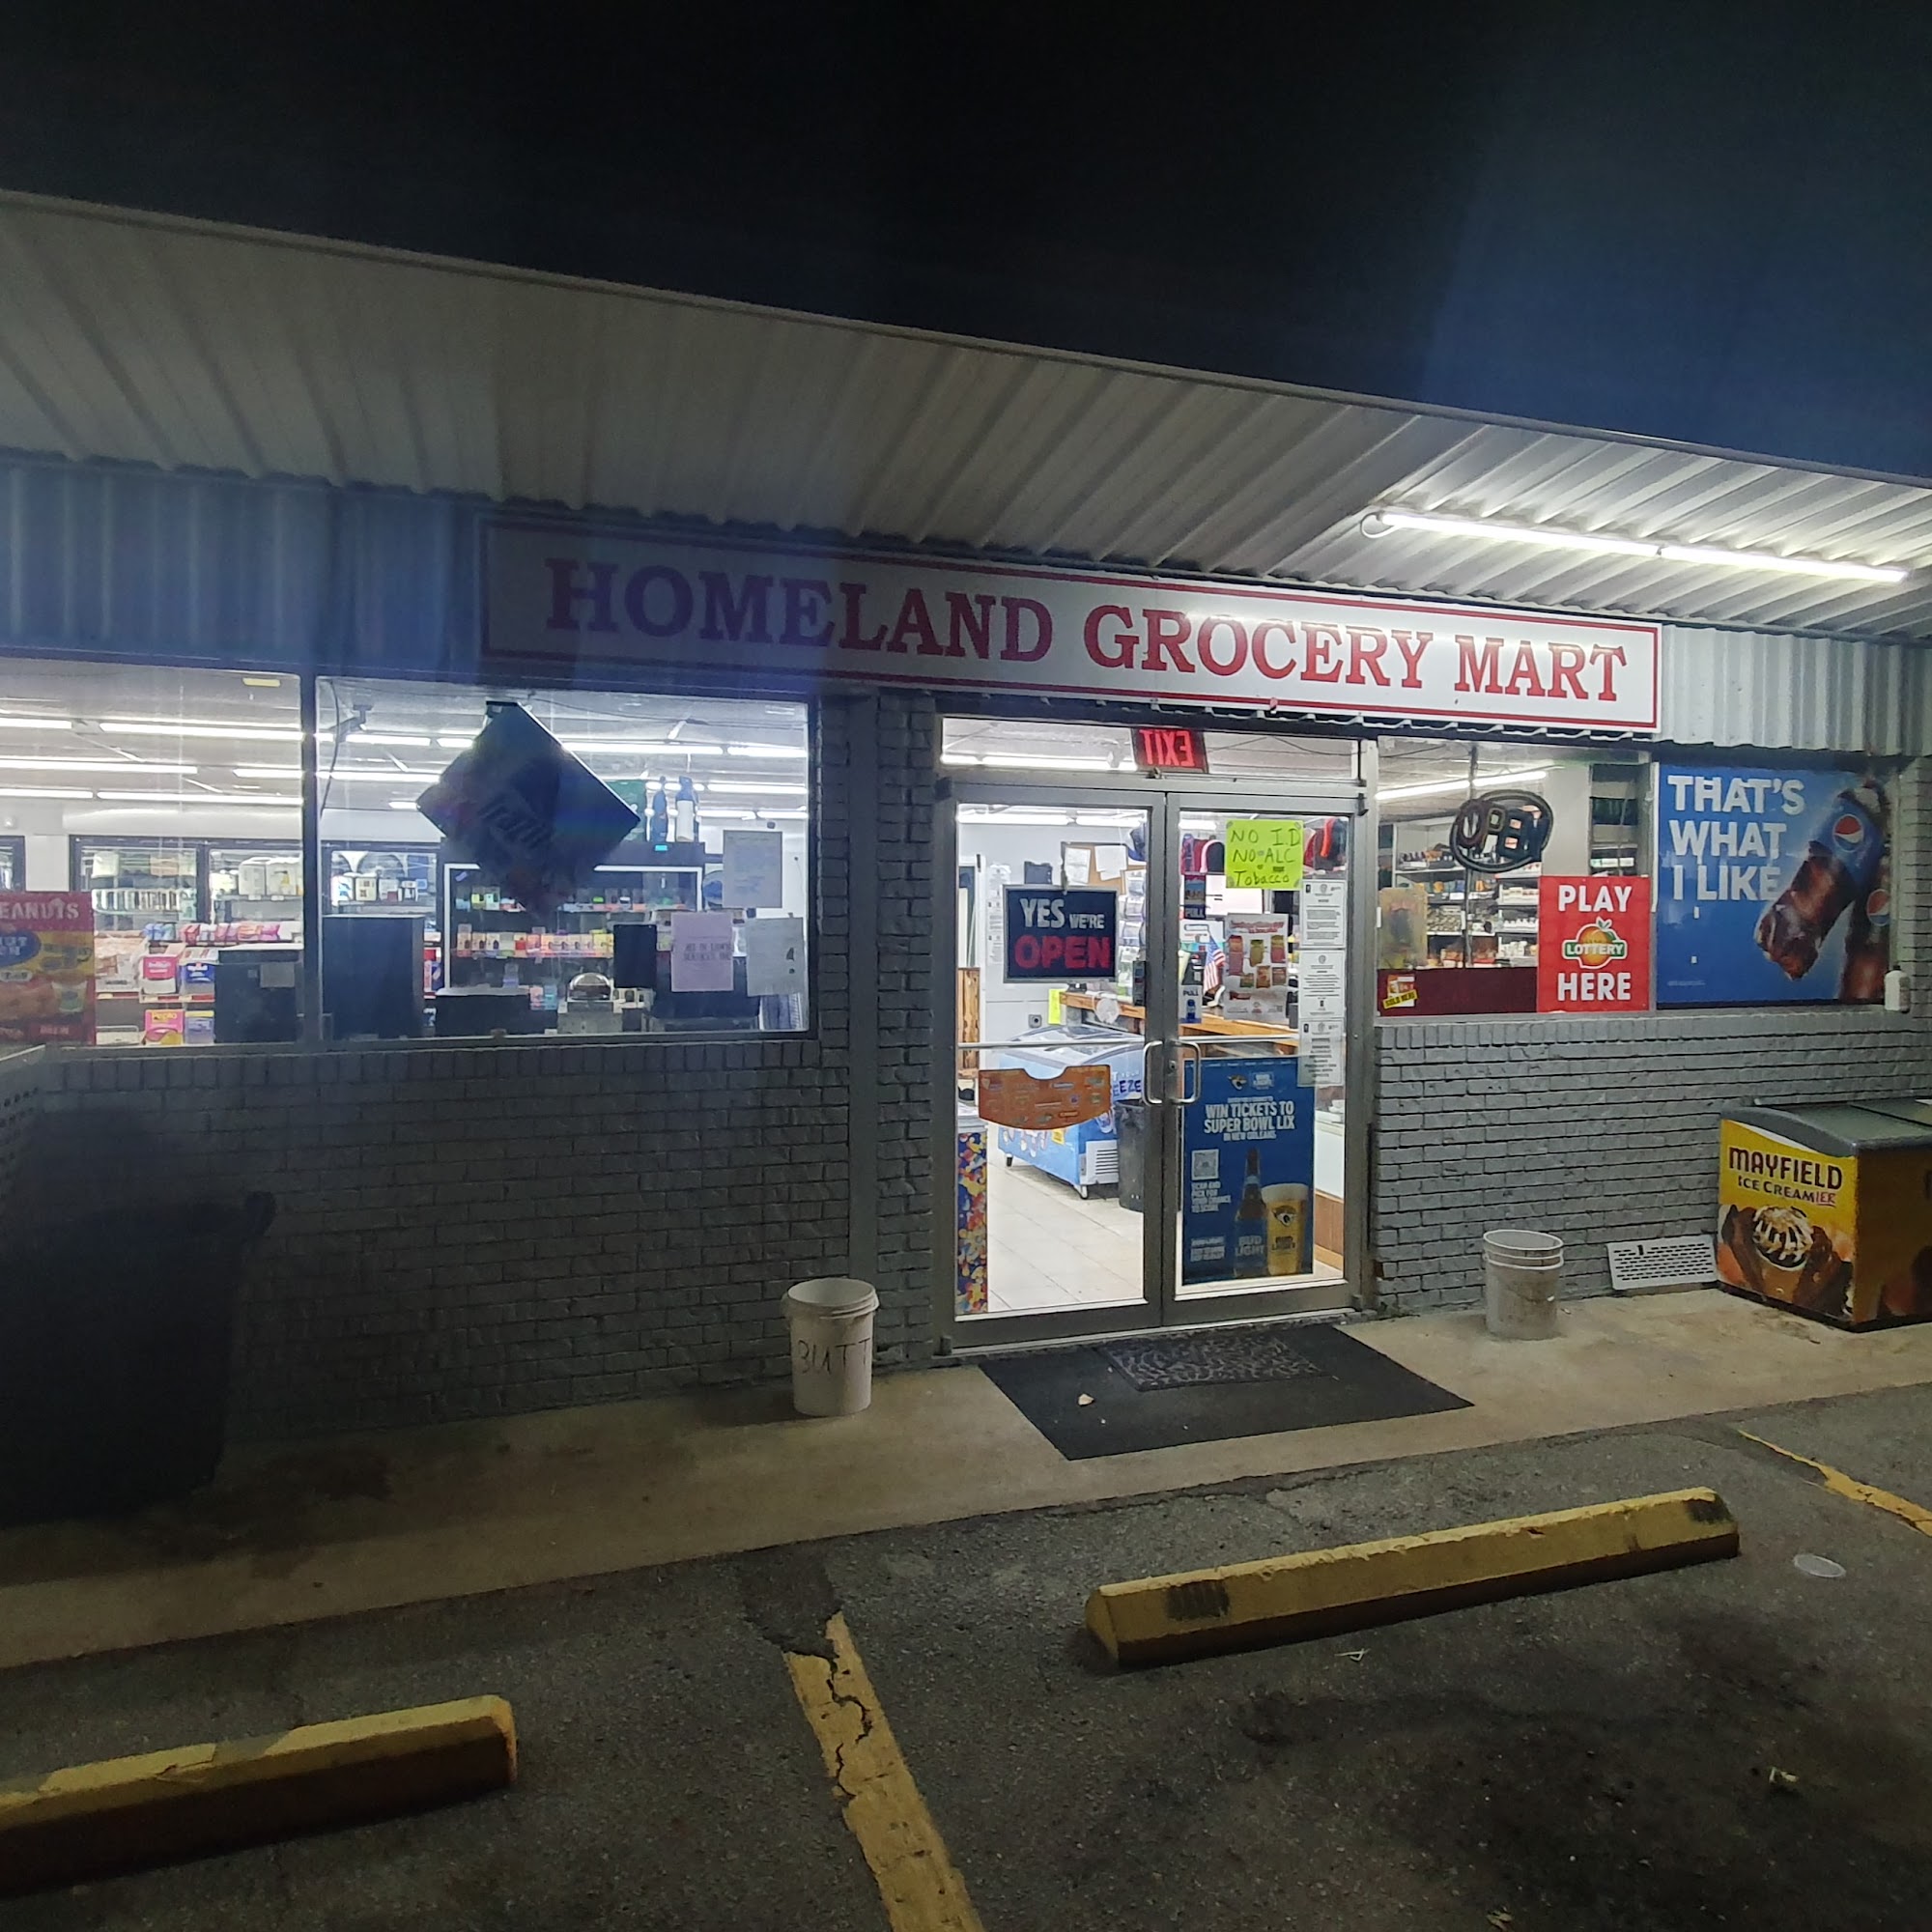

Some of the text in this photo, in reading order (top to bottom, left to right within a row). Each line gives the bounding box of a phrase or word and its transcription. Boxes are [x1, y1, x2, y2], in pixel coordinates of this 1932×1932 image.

[544, 557, 1628, 702] HOMELAND GROCERY MART
[1667, 775, 1805, 815] THAT'S
[1230, 829, 1260, 843] NO
[1668, 819, 1787, 860] WHAT
[1233, 847, 1296, 864] NO ALC
[1233, 870, 1290, 886] Tobacco
[1673, 865, 1781, 901] I LIKE
[1019, 897, 1105, 929] YES WE'RE
[1558, 884, 1633, 913] PLAY
[1015, 934, 1111, 970] OPEN
[1566, 943, 1624, 956] LOTTERY
[1557, 972, 1632, 1002] HERE
[1205, 1100, 1294, 1119] WIN TICKETS TO
[1204, 1115, 1295, 1134] SUPER BOWL LIX
[1728, 1146, 1843, 1191] MAYFIELD
[1738, 1176, 1760, 1192] ICE
